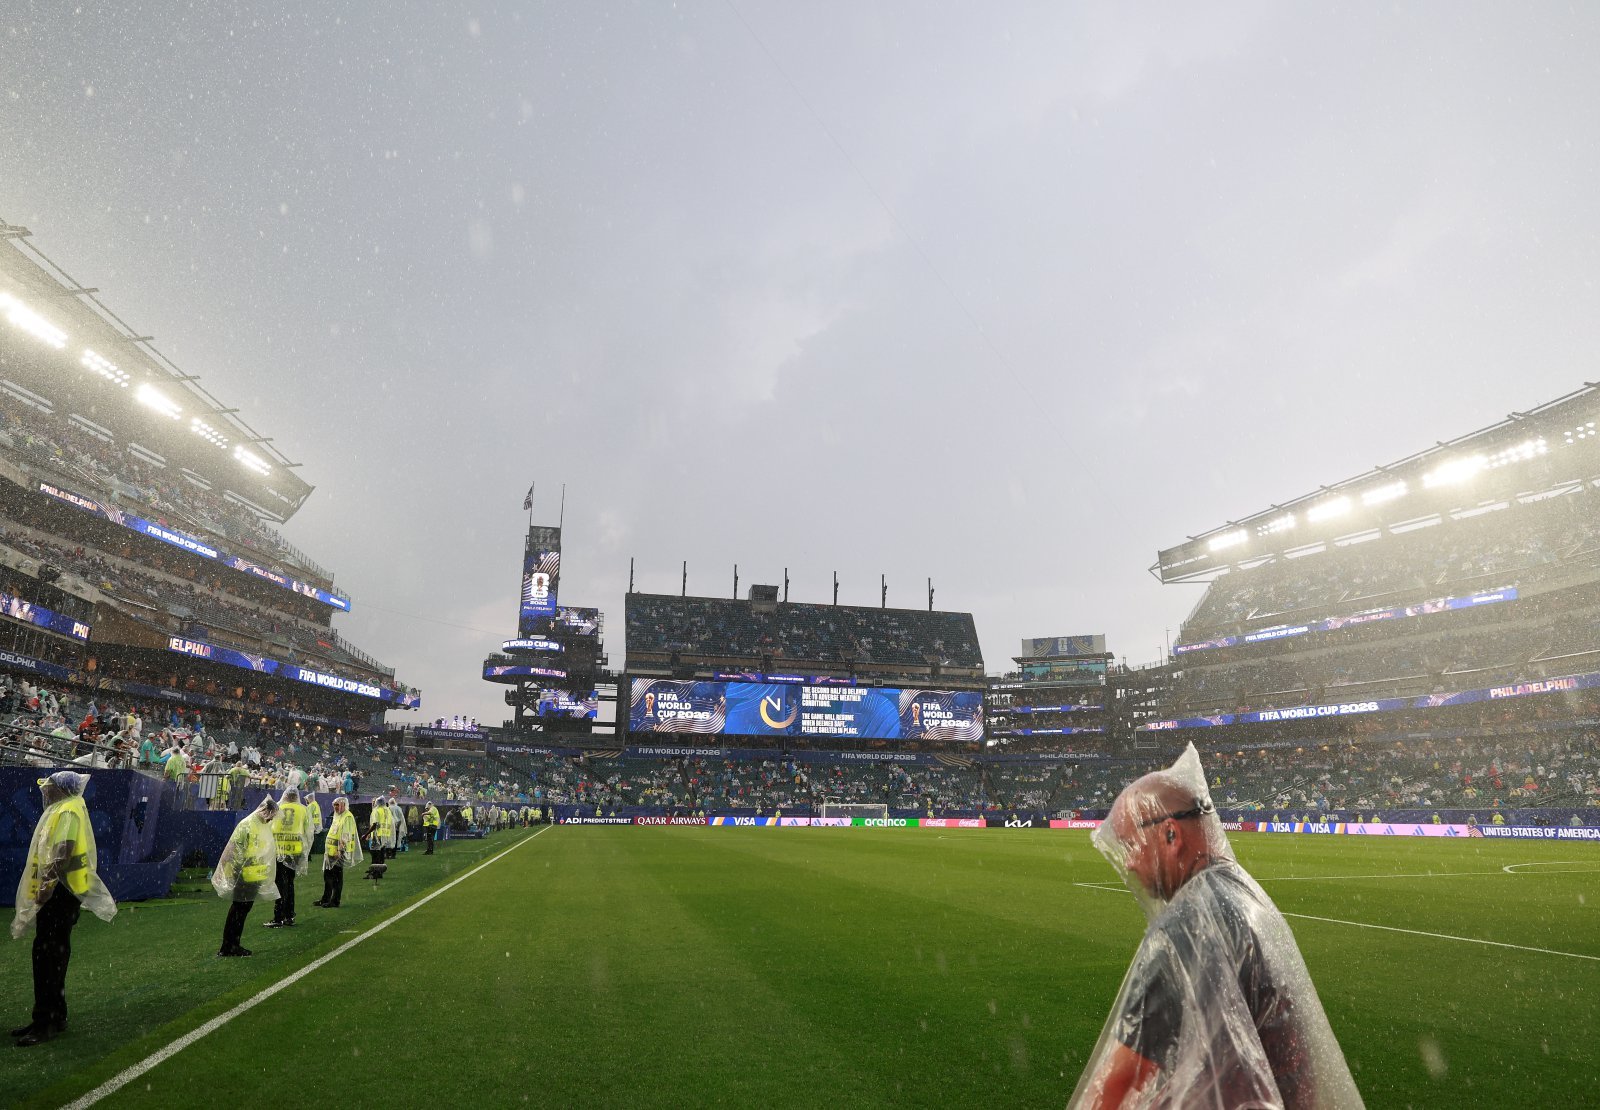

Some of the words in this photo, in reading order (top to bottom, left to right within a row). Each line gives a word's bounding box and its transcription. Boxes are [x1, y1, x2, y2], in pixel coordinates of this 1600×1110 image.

[40, 484, 97, 511] PHILADELPHIA
[148, 526, 162, 537] FIFA
[162, 531, 184, 545] WORLD
[184, 540, 198, 550] CUP
[197, 545, 217, 558] 2026
[1256, 632, 1276, 640] WORLD
[299, 669, 316, 683] FIFA
[317, 674, 344, 688] WORLD
[344, 680, 358, 692] CUP
[358, 684, 380, 698] 2026
[1490, 678, 1576, 698] PHILADELPHIA
[658, 702, 692, 710] WORLD
[1260, 712, 1280, 720] FIFA
[1280, 708, 1316, 719] WORLD
[1317, 706, 1338, 716] CUP
[1340, 702, 1379, 714] 2026
[288, 712, 328, 723] PHILADELPHIA
[677, 711, 710, 719] 2026
[638, 817, 666, 825] QATAR
[734, 817, 755, 826] VISA
[1271, 823, 1290, 832] VISA
[1308, 823, 1330, 833] VISA
[1482, 827, 1511, 836] UNITED
[1512, 828, 1543, 837] STATES
[1544, 828, 1556, 837] OF
[1558, 828, 1600, 838] AMERICA
